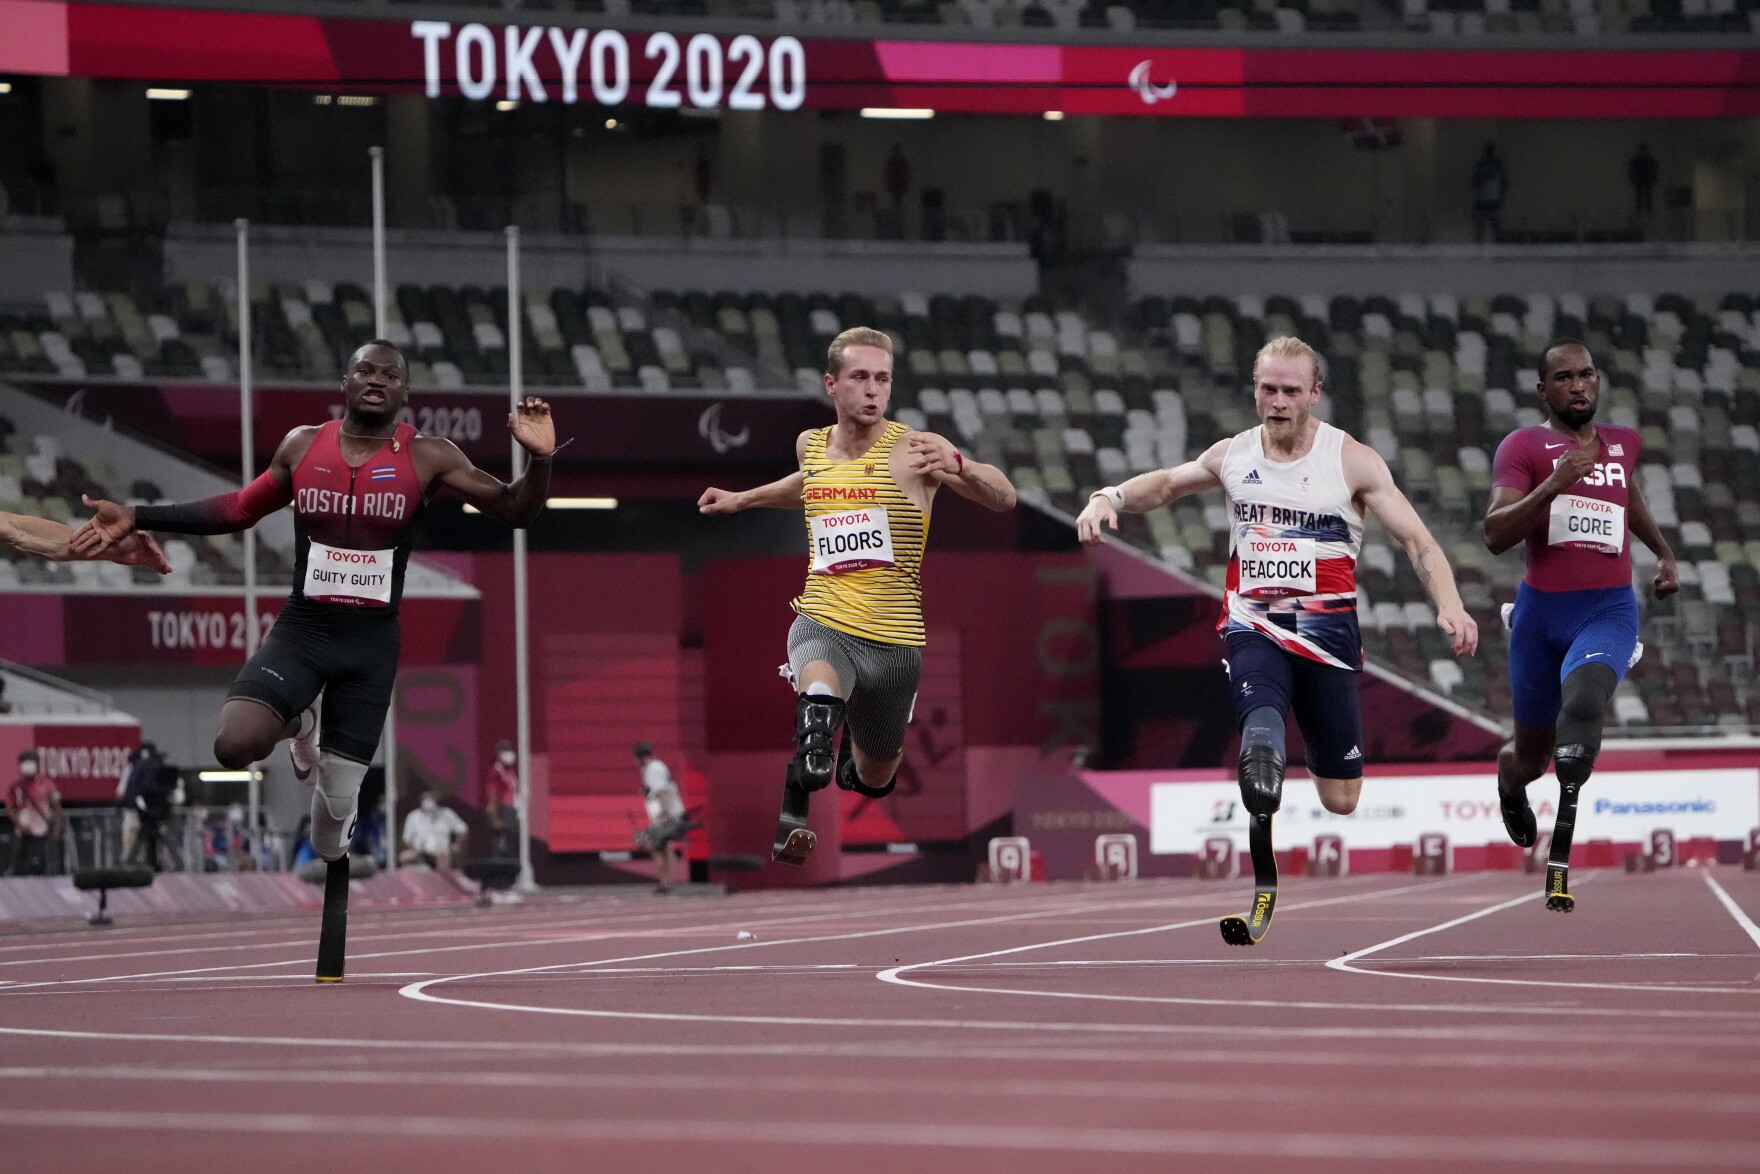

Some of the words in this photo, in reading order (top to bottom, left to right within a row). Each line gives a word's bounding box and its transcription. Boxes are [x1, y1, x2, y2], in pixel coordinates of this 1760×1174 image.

[411, 20, 630, 105] TOKYO
[644, 31, 806, 111] 2020
[418, 406, 483, 441] 2020
[1553, 459, 1627, 488] SA
[298, 487, 357, 515] COSTA
[363, 492, 406, 520] RICA
[806, 487, 877, 500] GERMANY
[1234, 502, 1267, 522] REAT
[1569, 499, 1613, 514] TOYOTA
[822, 513, 870, 528] TOYOTA
[1568, 515, 1613, 536] GORE
[818, 530, 884, 556] FLOORS
[1250, 542, 1297, 552] TOYOTA
[326, 550, 377, 564] TOYOTA
[313, 569, 347, 584] GUITY
[351, 574, 386, 586] GUITY
[1241, 560, 1313, 578] PEACOCK
[148, 611, 227, 649] TOKYO
[1441, 799, 1556, 820] TOYA
[1595, 795, 1716, 815] Panasonic
[1654, 834, 1671, 864] 3
